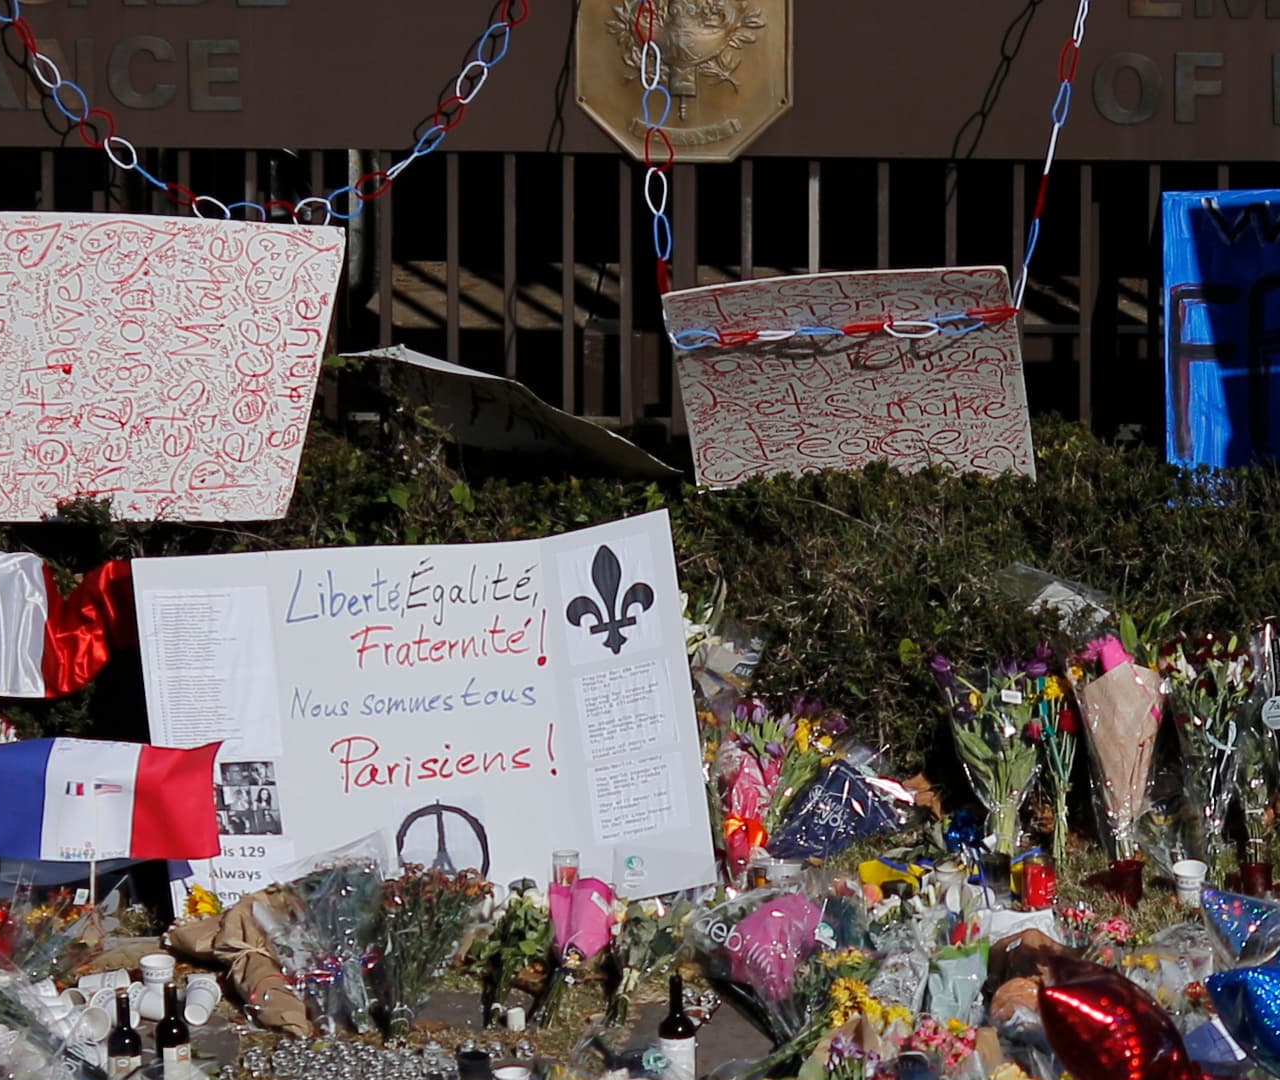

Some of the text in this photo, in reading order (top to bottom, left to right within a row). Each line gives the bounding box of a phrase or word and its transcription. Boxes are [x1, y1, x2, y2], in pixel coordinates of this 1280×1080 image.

[1092, 52, 1223, 126] OF
[292, 676, 537, 721] Nous sommes tous
[239, 845, 266, 858] 129
